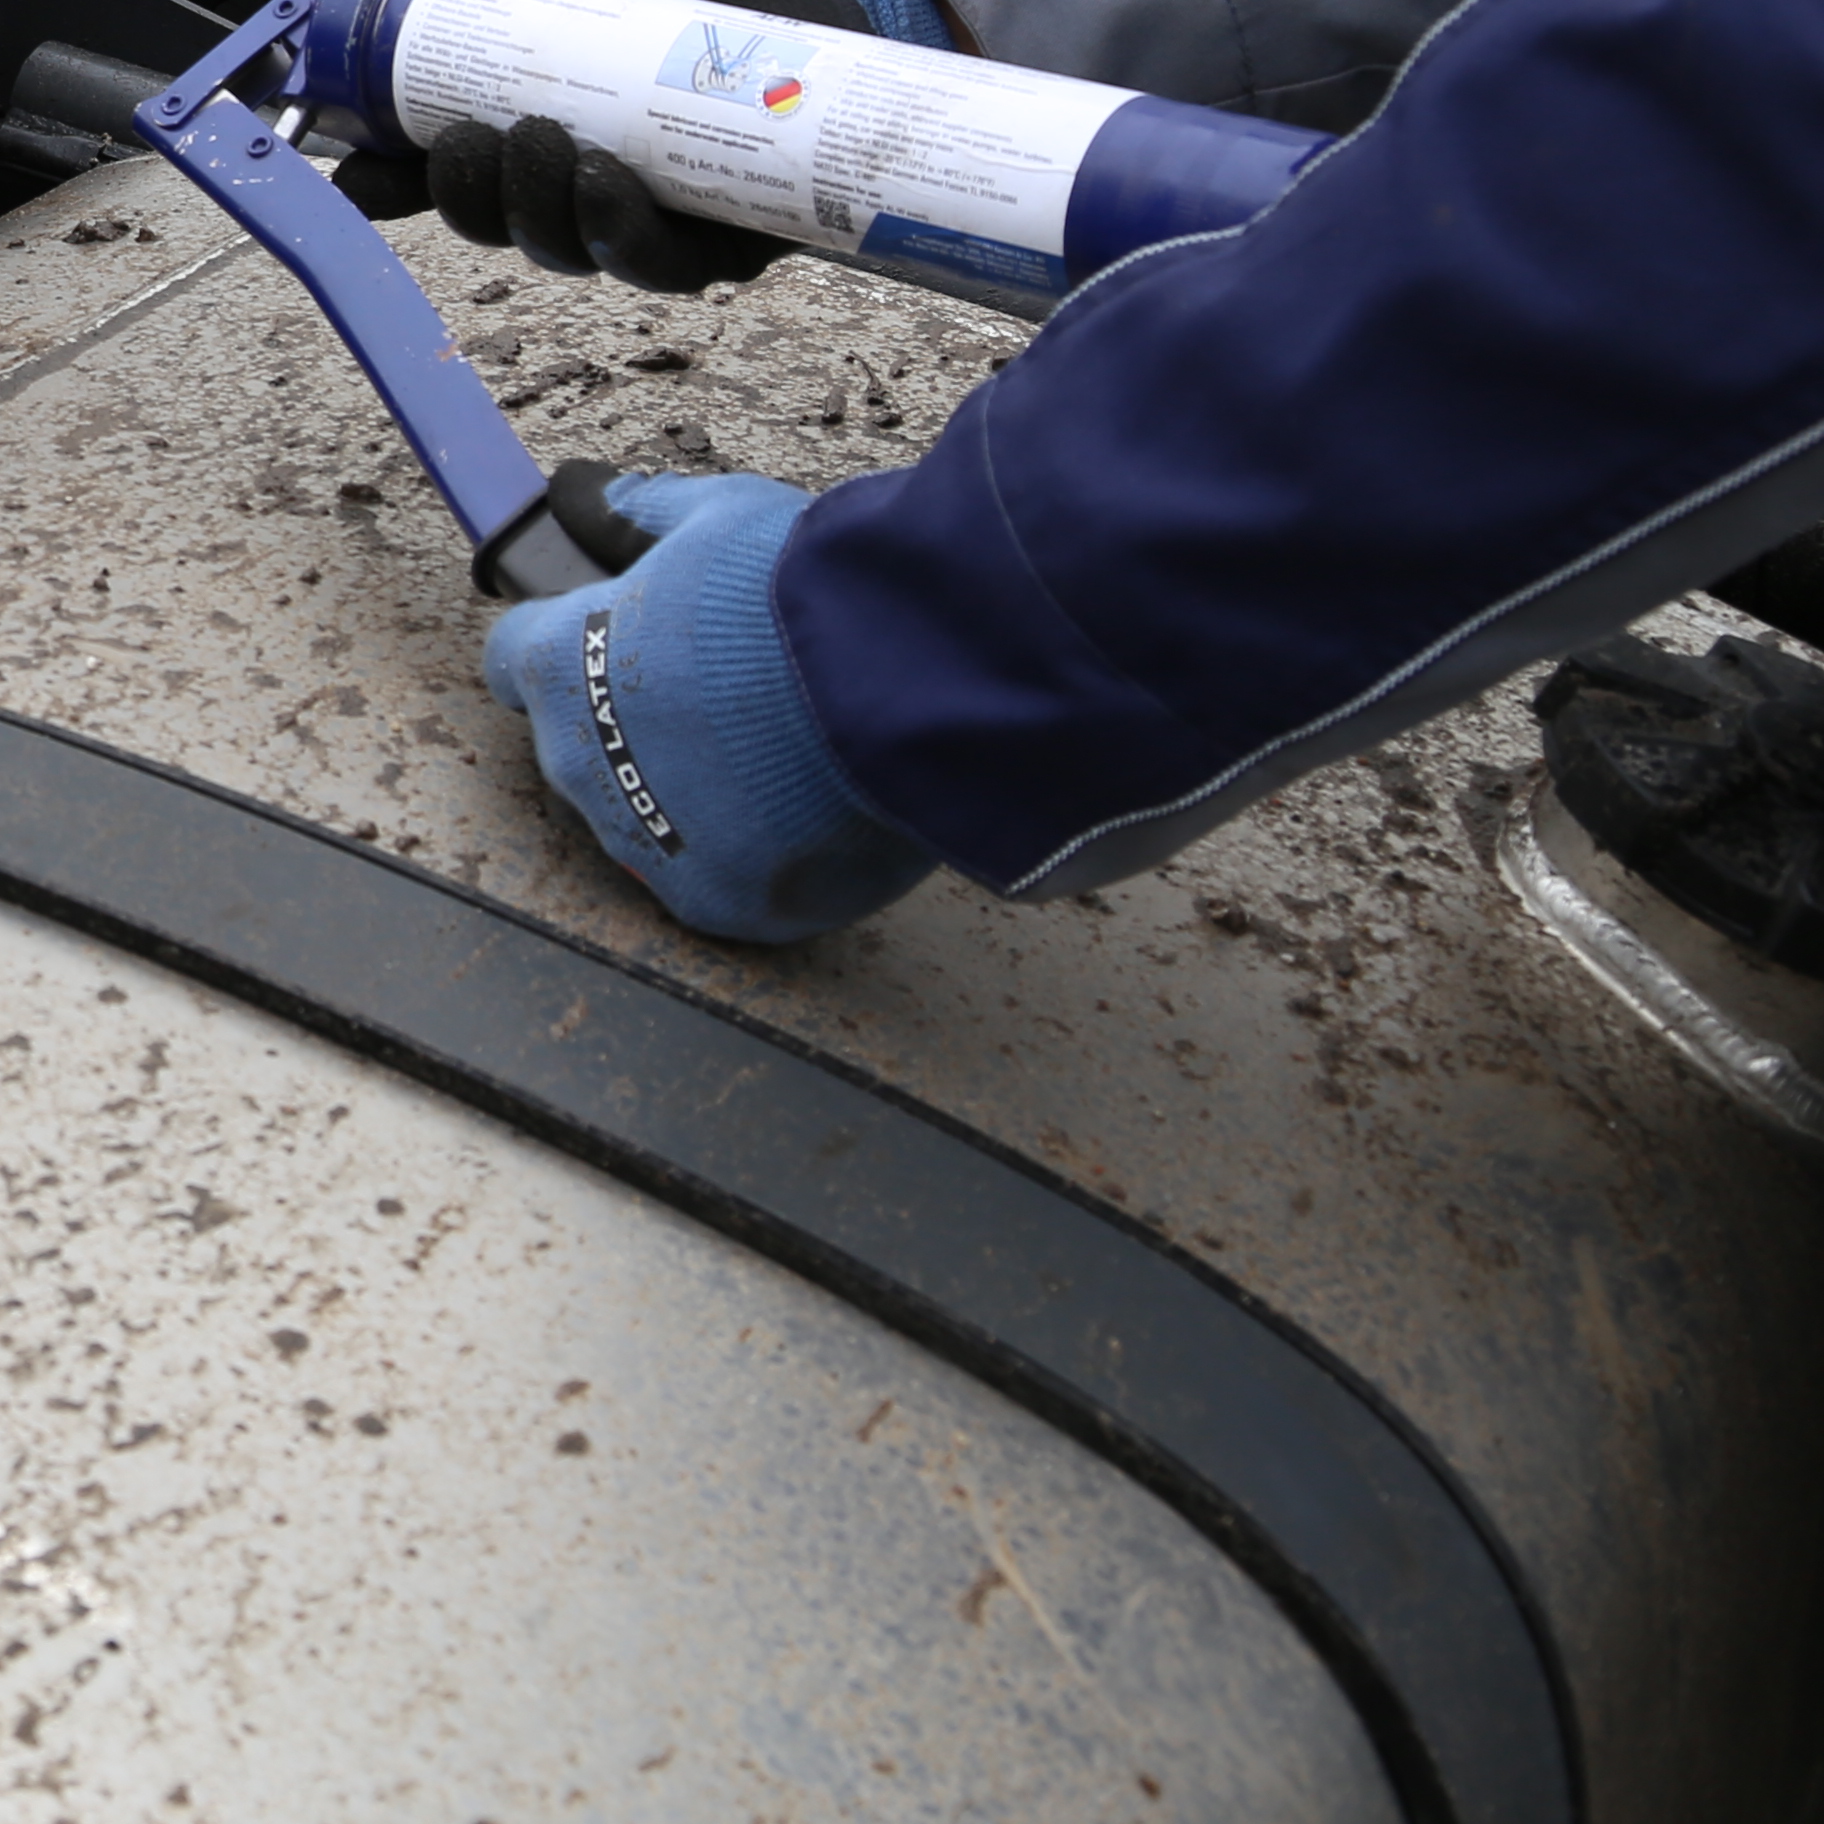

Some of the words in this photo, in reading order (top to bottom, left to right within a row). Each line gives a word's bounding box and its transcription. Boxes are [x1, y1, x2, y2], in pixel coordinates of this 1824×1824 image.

[666, 151, 687, 166] 400
[687, 159, 697, 170] g
[741, 169, 797, 193] 26450040
[919, 173, 944, 187] Armed
[585, 626, 624, 752] LATEX
[615, 762, 672, 838] ECO
